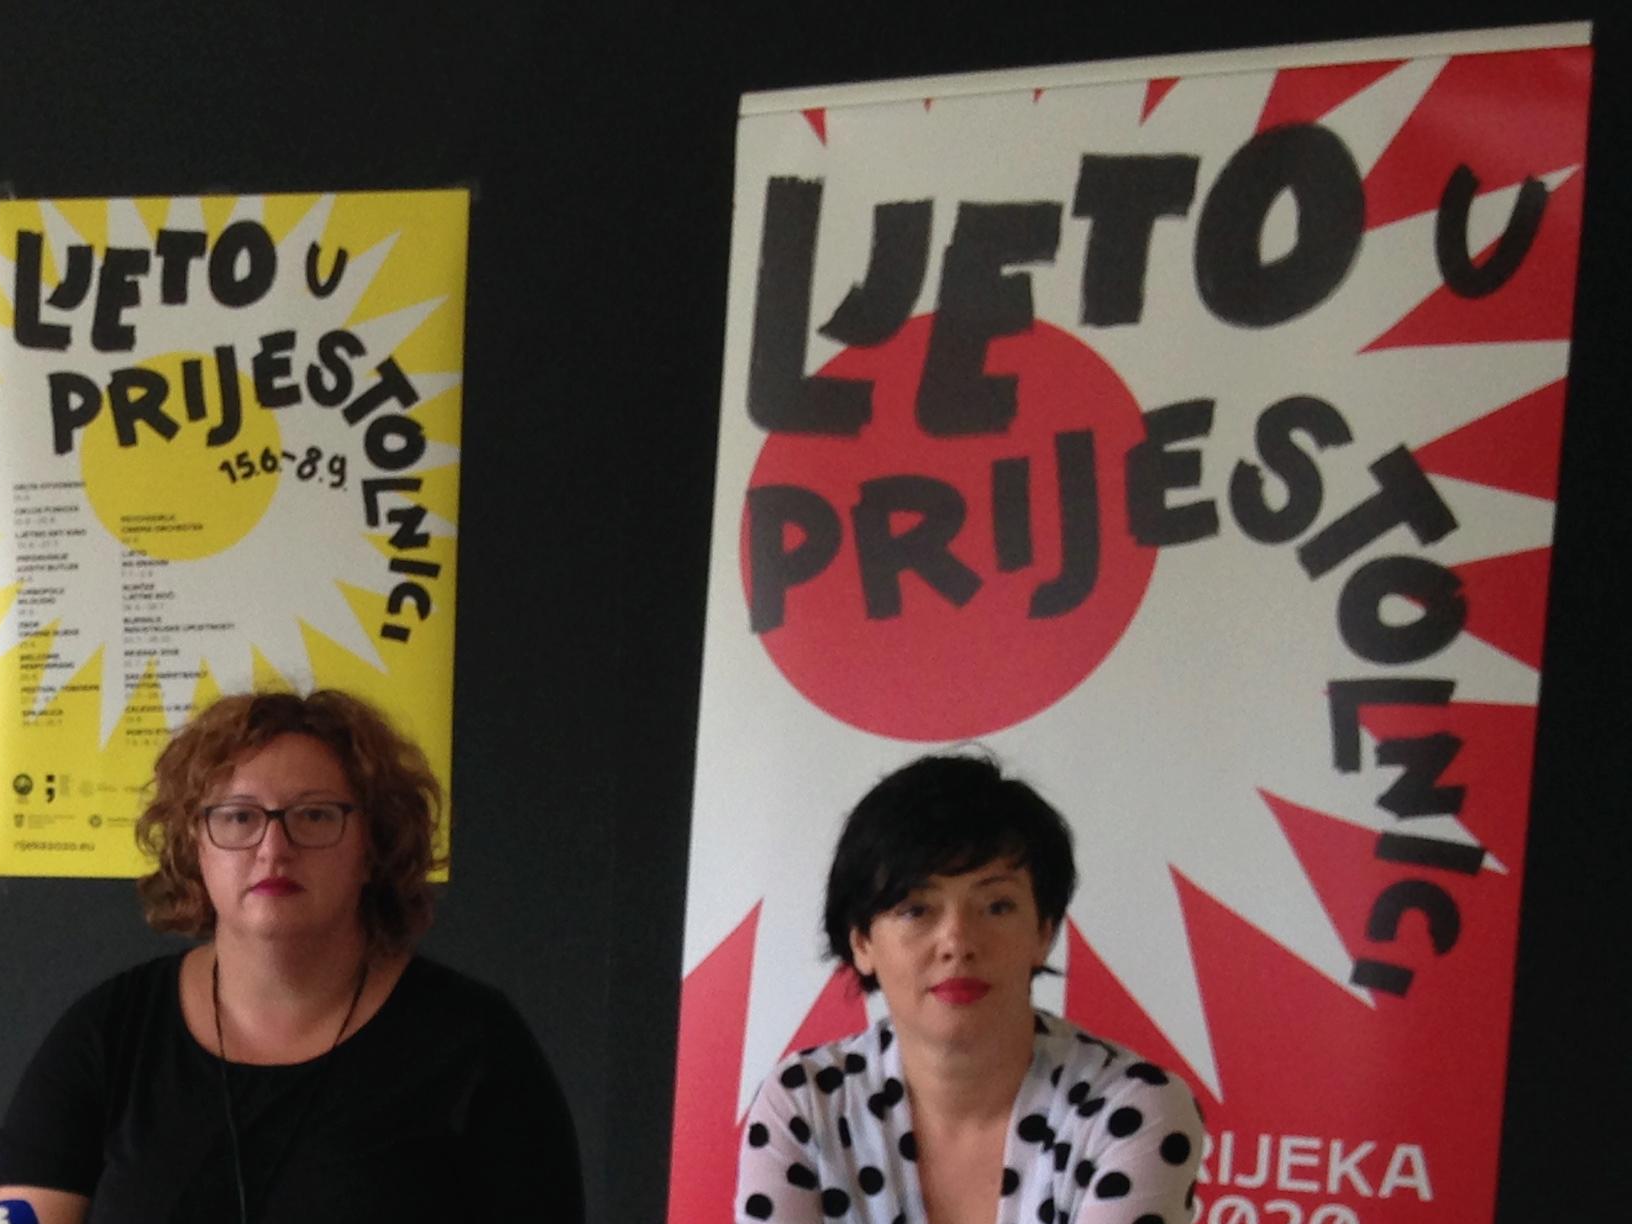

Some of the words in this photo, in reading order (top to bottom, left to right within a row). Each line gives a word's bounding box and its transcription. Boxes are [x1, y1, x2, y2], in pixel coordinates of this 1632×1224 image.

[13, 219, 278, 353] LJETO
[305, 240, 348, 299] U
[746, 121, 1367, 438] LJETO
[1434, 162, 1550, 301] U
[47, 328, 442, 644] PRIJESTOLNICI
[746, 393, 1488, 998] PRIJESTOLNICI
